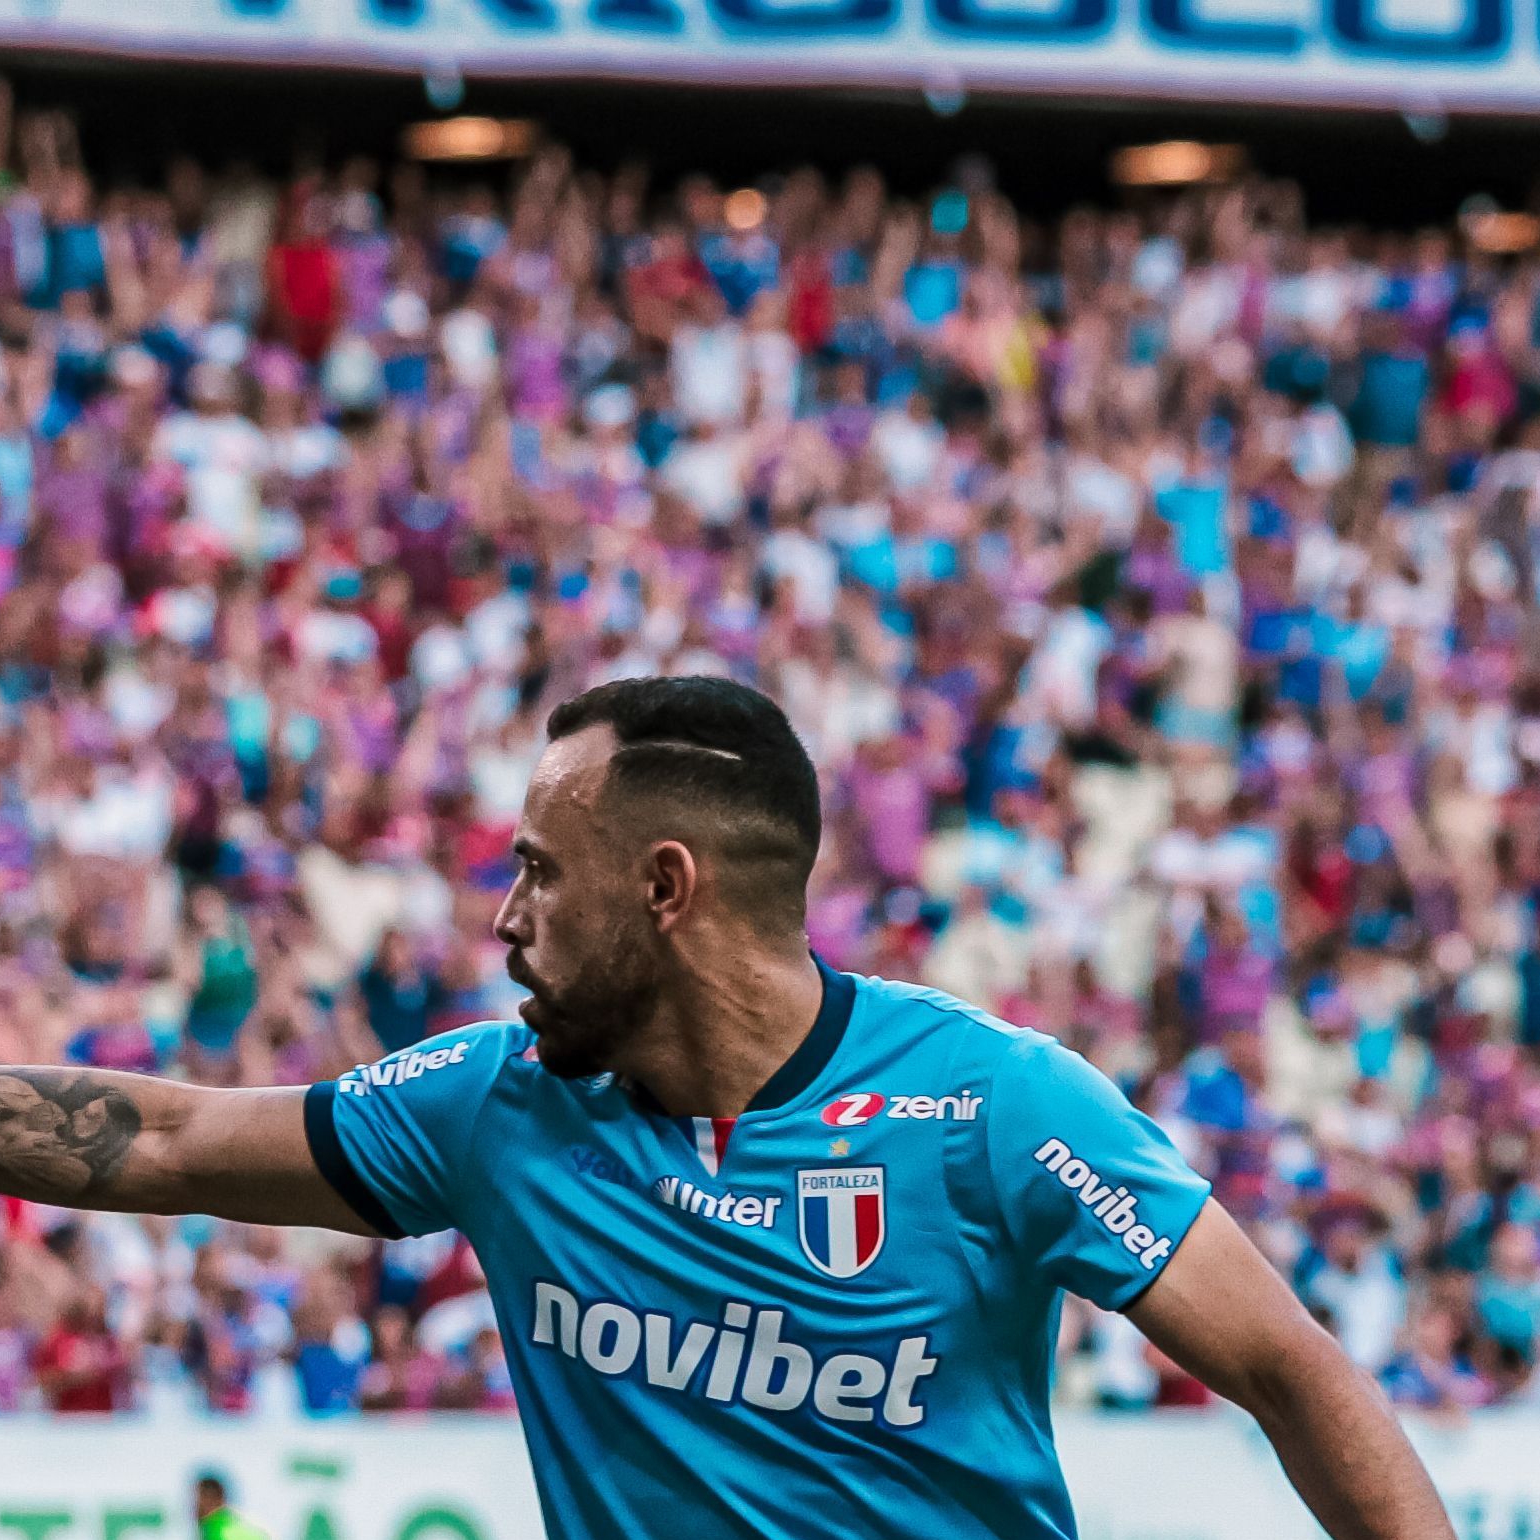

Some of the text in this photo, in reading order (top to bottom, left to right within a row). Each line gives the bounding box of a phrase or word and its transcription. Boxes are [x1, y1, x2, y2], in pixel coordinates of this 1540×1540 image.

[887, 1090, 983, 1121] zenir
[802, 1175, 879, 1190] FORTALEZA
[1034, 1138, 1172, 1270] novibet
[533, 1282, 937, 1426] novibet
